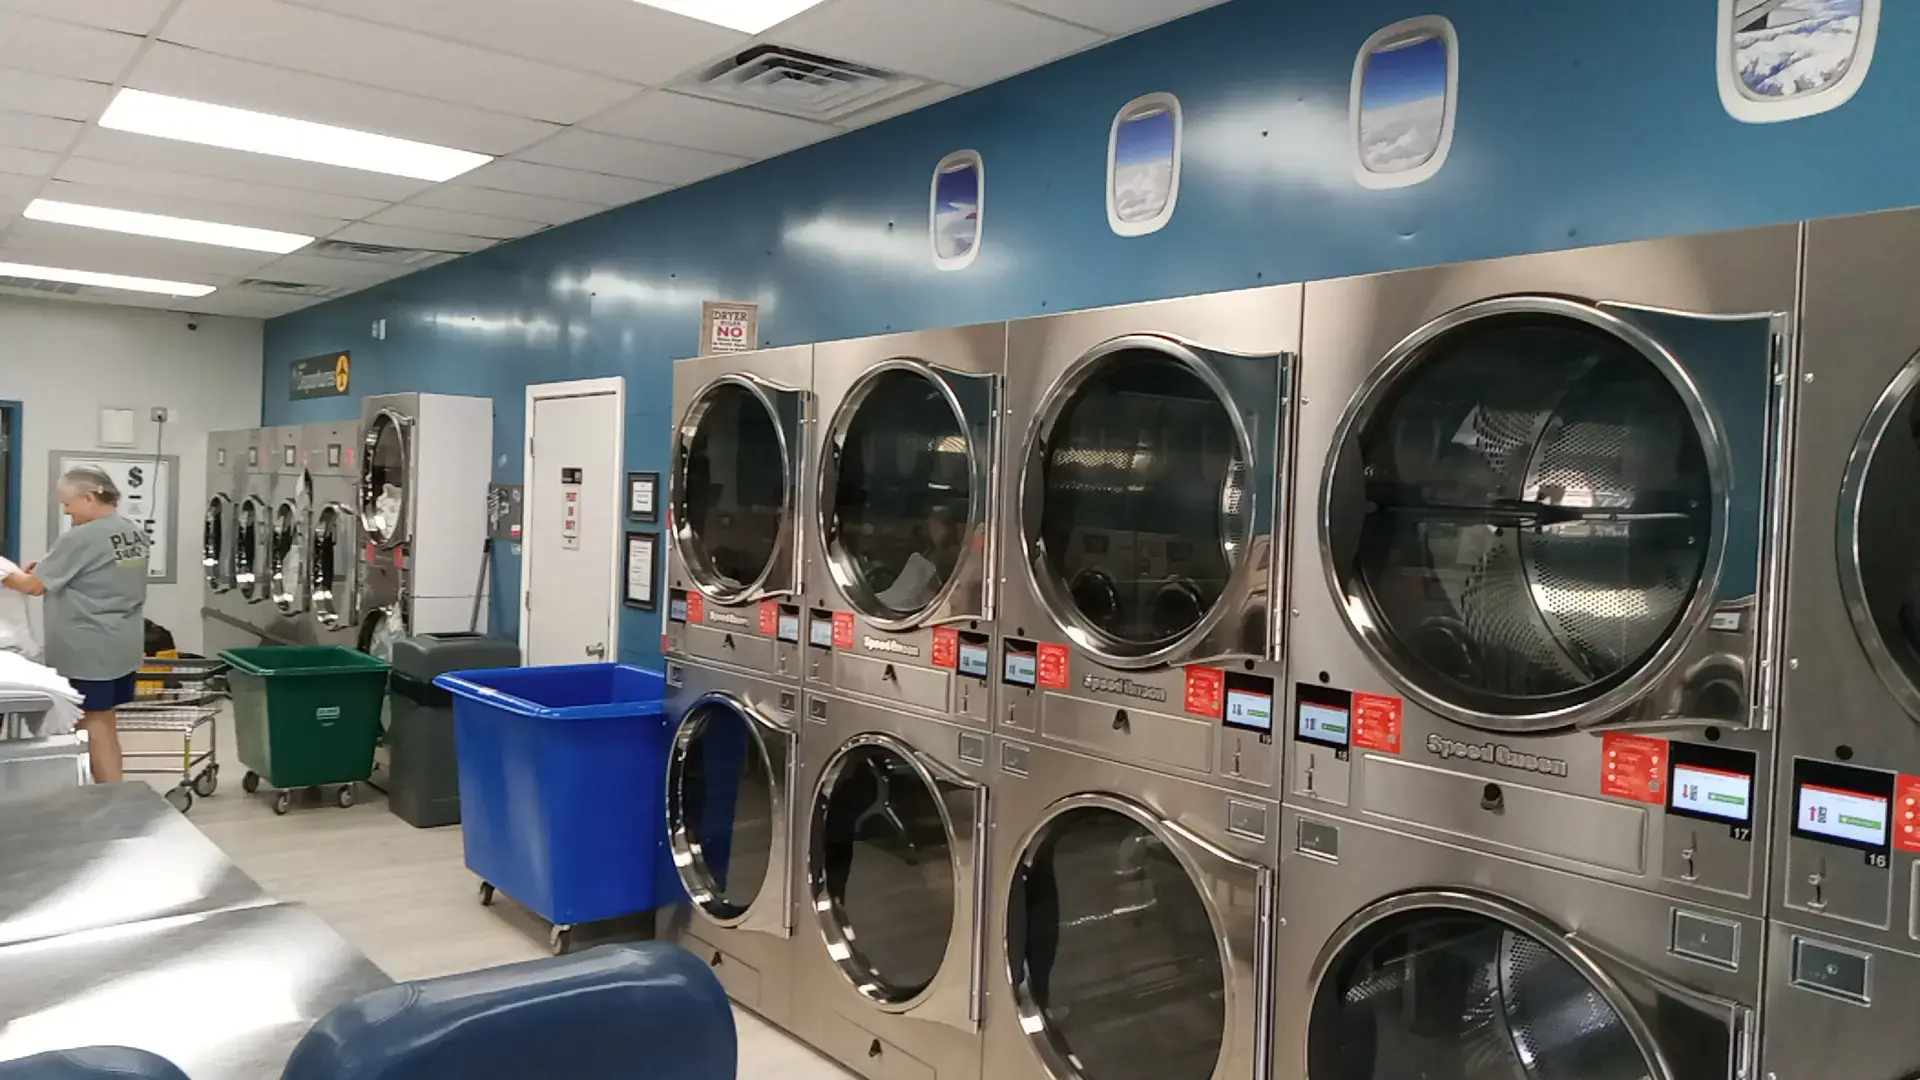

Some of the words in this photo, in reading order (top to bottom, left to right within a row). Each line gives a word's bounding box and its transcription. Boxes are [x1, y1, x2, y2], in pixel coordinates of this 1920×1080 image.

[713, 311, 748, 321] DRYER
[717, 326, 743, 337] NO
[1083, 673, 1123, 694] Speed
[1427, 733, 1495, 763] Speed
[1494, 744, 1568, 777] Queen
[1734, 827, 1749, 840] 17
[1869, 853, 1886, 867] 16
